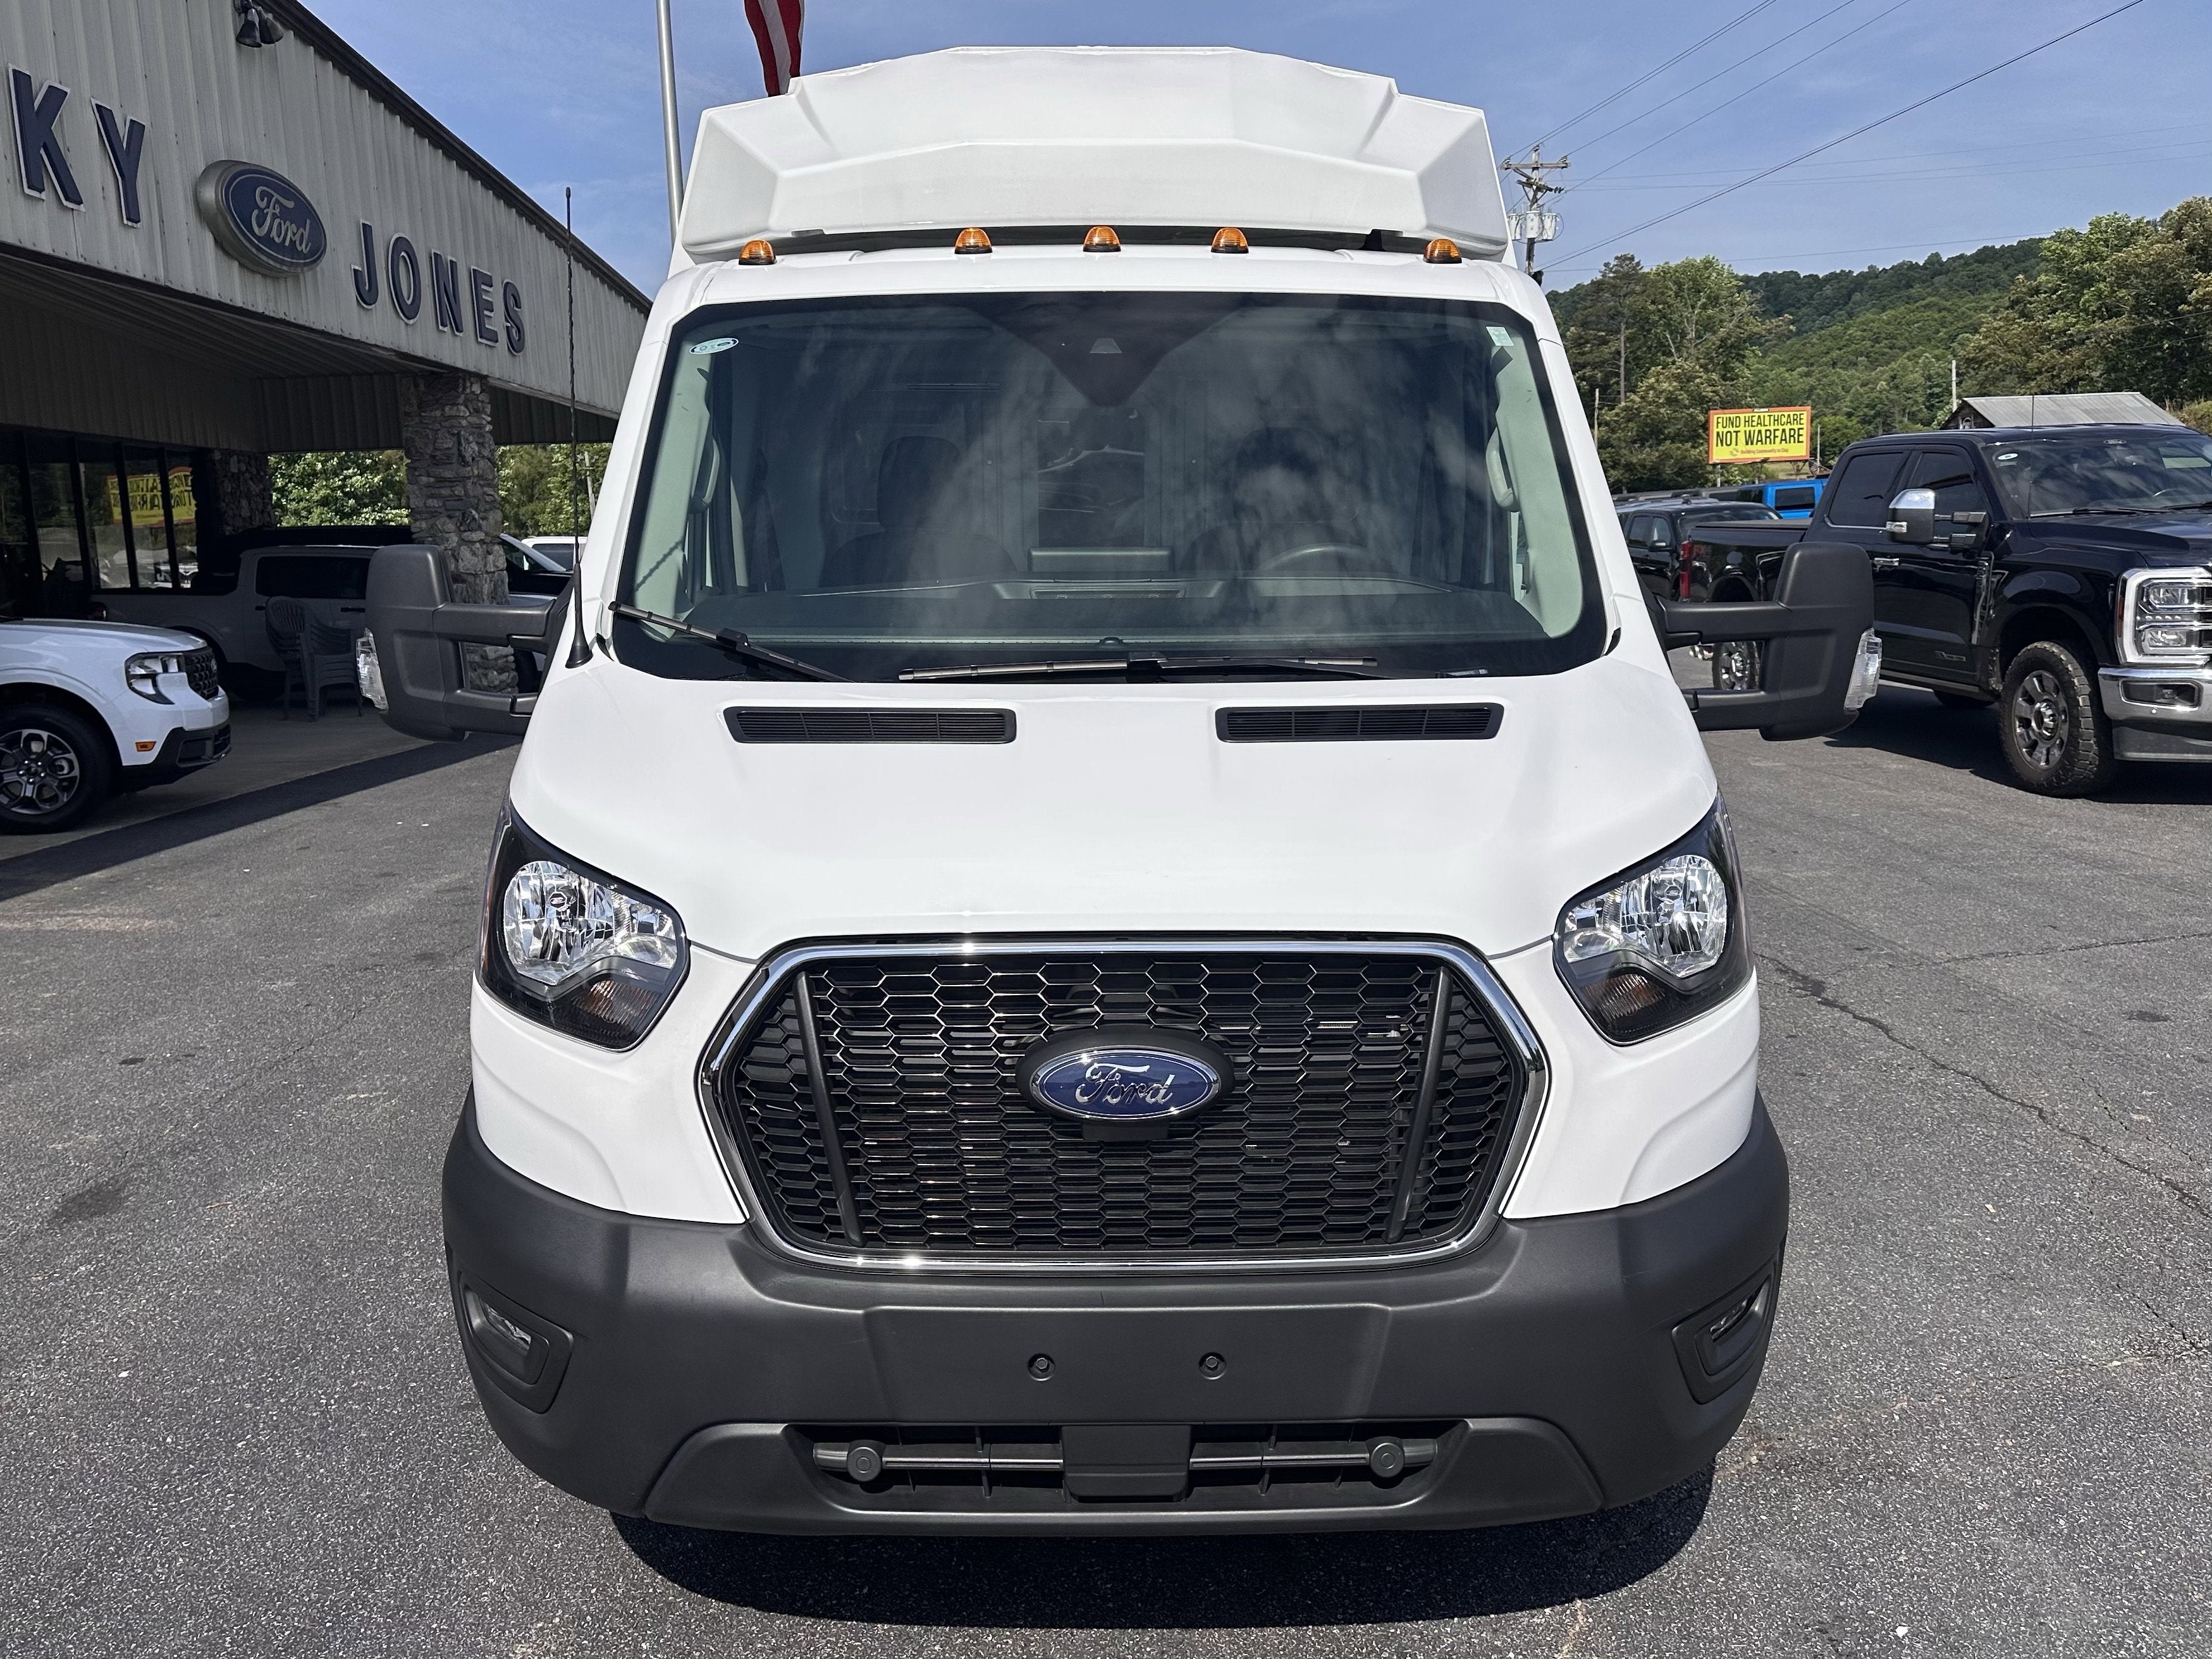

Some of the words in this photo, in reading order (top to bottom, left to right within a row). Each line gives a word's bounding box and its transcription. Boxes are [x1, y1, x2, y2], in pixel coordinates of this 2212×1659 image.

[9, 64, 146, 227] KY
[351, 219, 525, 355] JONES
[252, 186, 311, 254] Ford
[1716, 416, 1741, 429] FUND
[1744, 413, 1804, 427] HEALTHCARE
[1716, 431, 1740, 447] NOT
[1744, 427, 1804, 446] WARFARE
[1075, 1063, 1175, 1105] Ford
